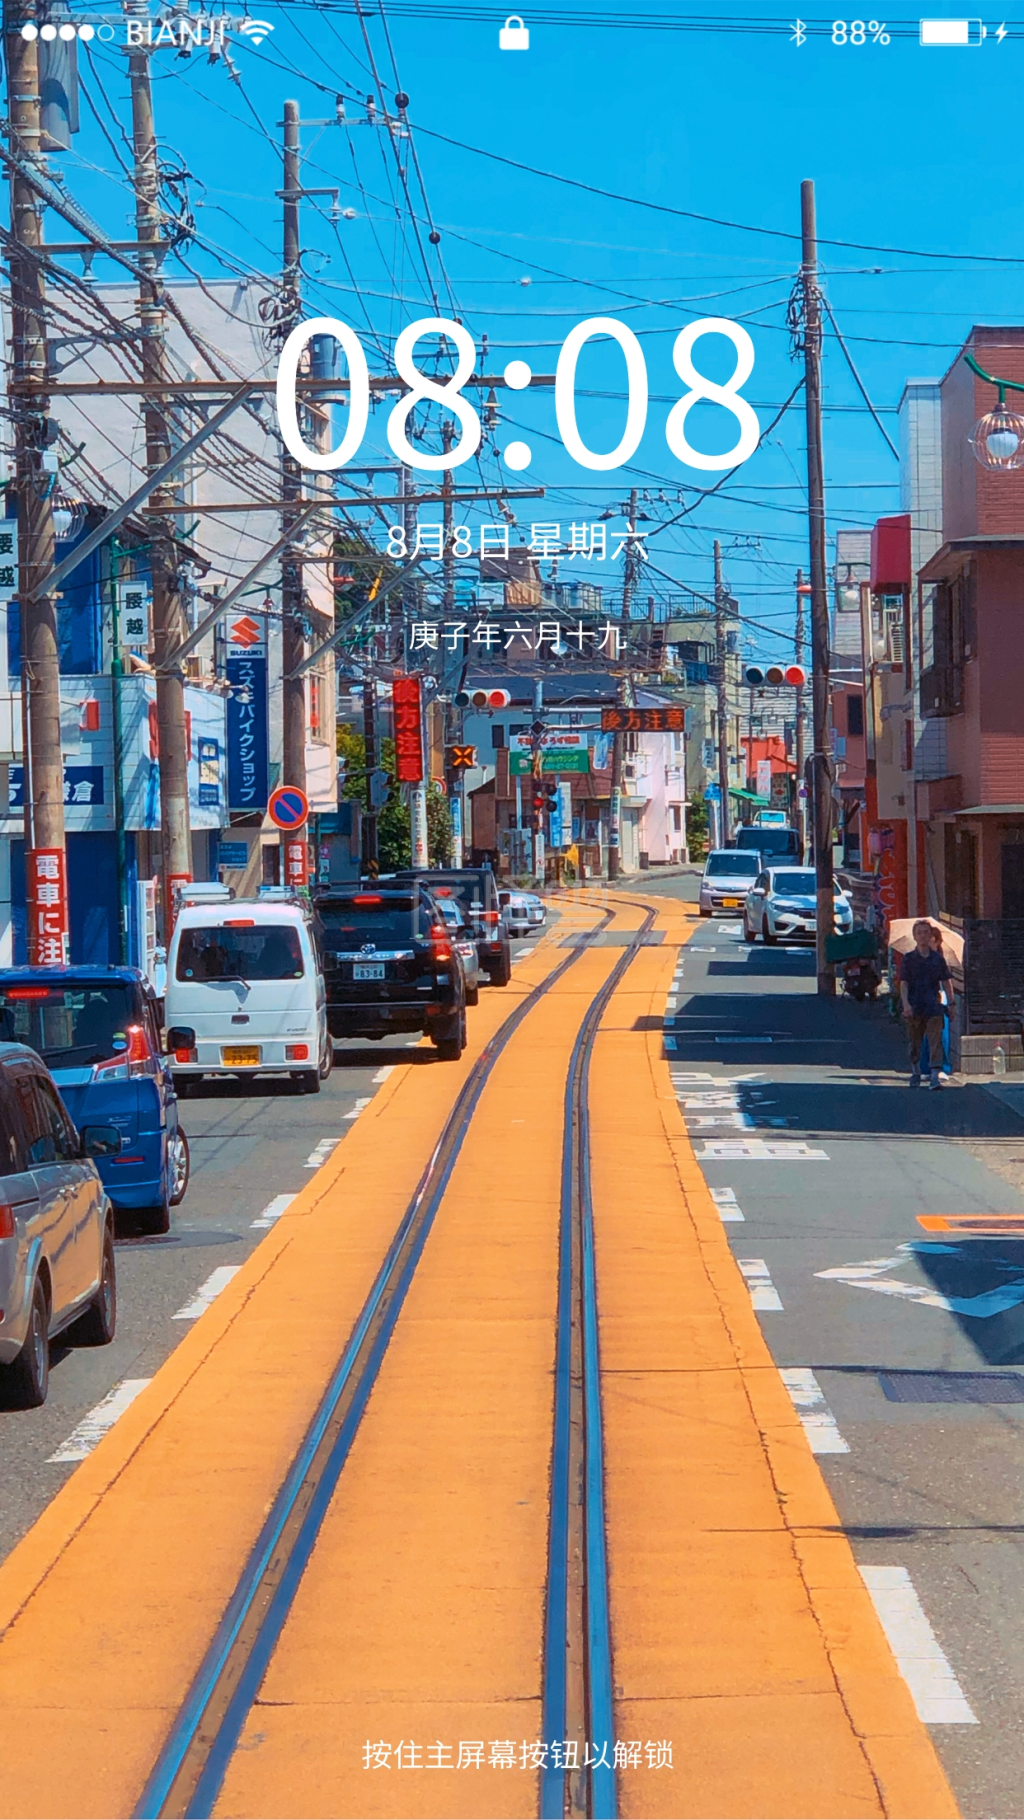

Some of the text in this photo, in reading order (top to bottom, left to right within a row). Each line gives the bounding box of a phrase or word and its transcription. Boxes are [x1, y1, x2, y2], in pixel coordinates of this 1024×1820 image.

[125, 591, 144, 635] 腰越
[394, 679, 421, 781] 後方注意
[602, 710, 684, 731] 後方注意
